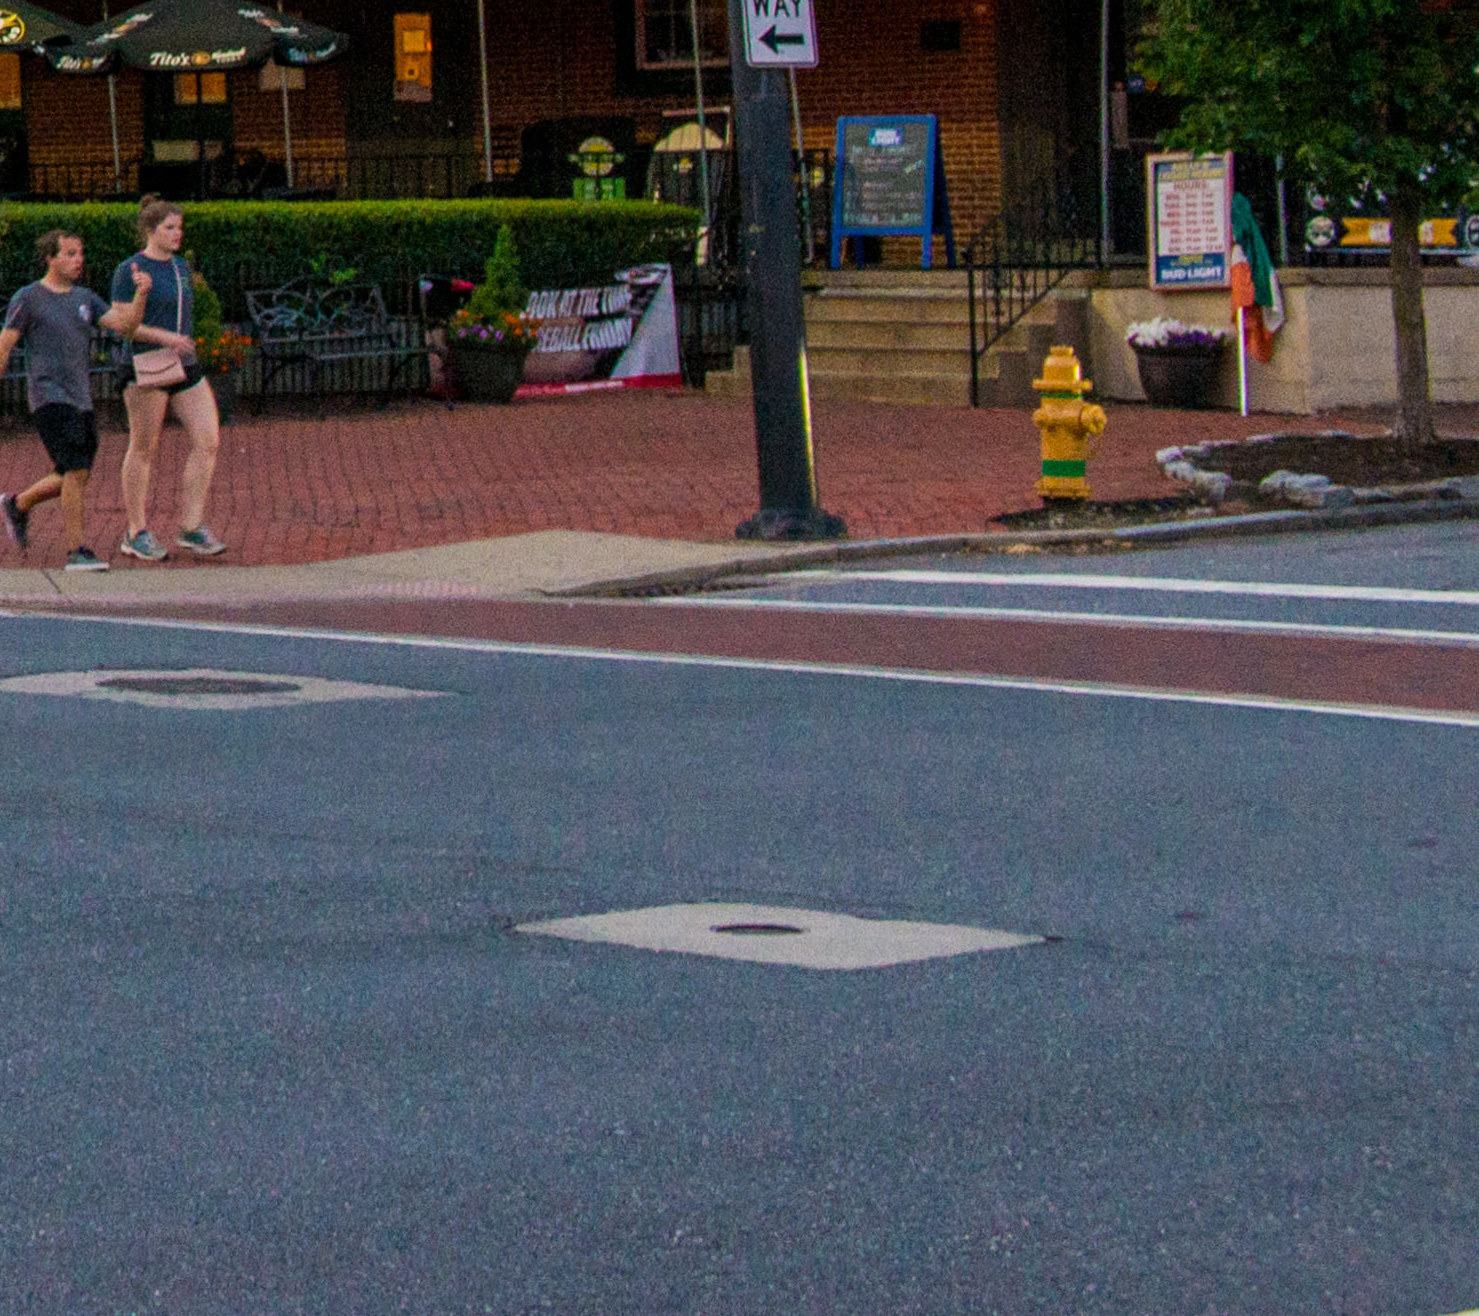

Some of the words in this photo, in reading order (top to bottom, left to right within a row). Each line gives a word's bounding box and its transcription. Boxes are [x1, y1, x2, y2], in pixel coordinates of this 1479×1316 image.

[150, 51, 191, 67] Tito's
[1161, 269, 1187, 280] BUD
[1188, 266, 1222, 278] LIGHT
